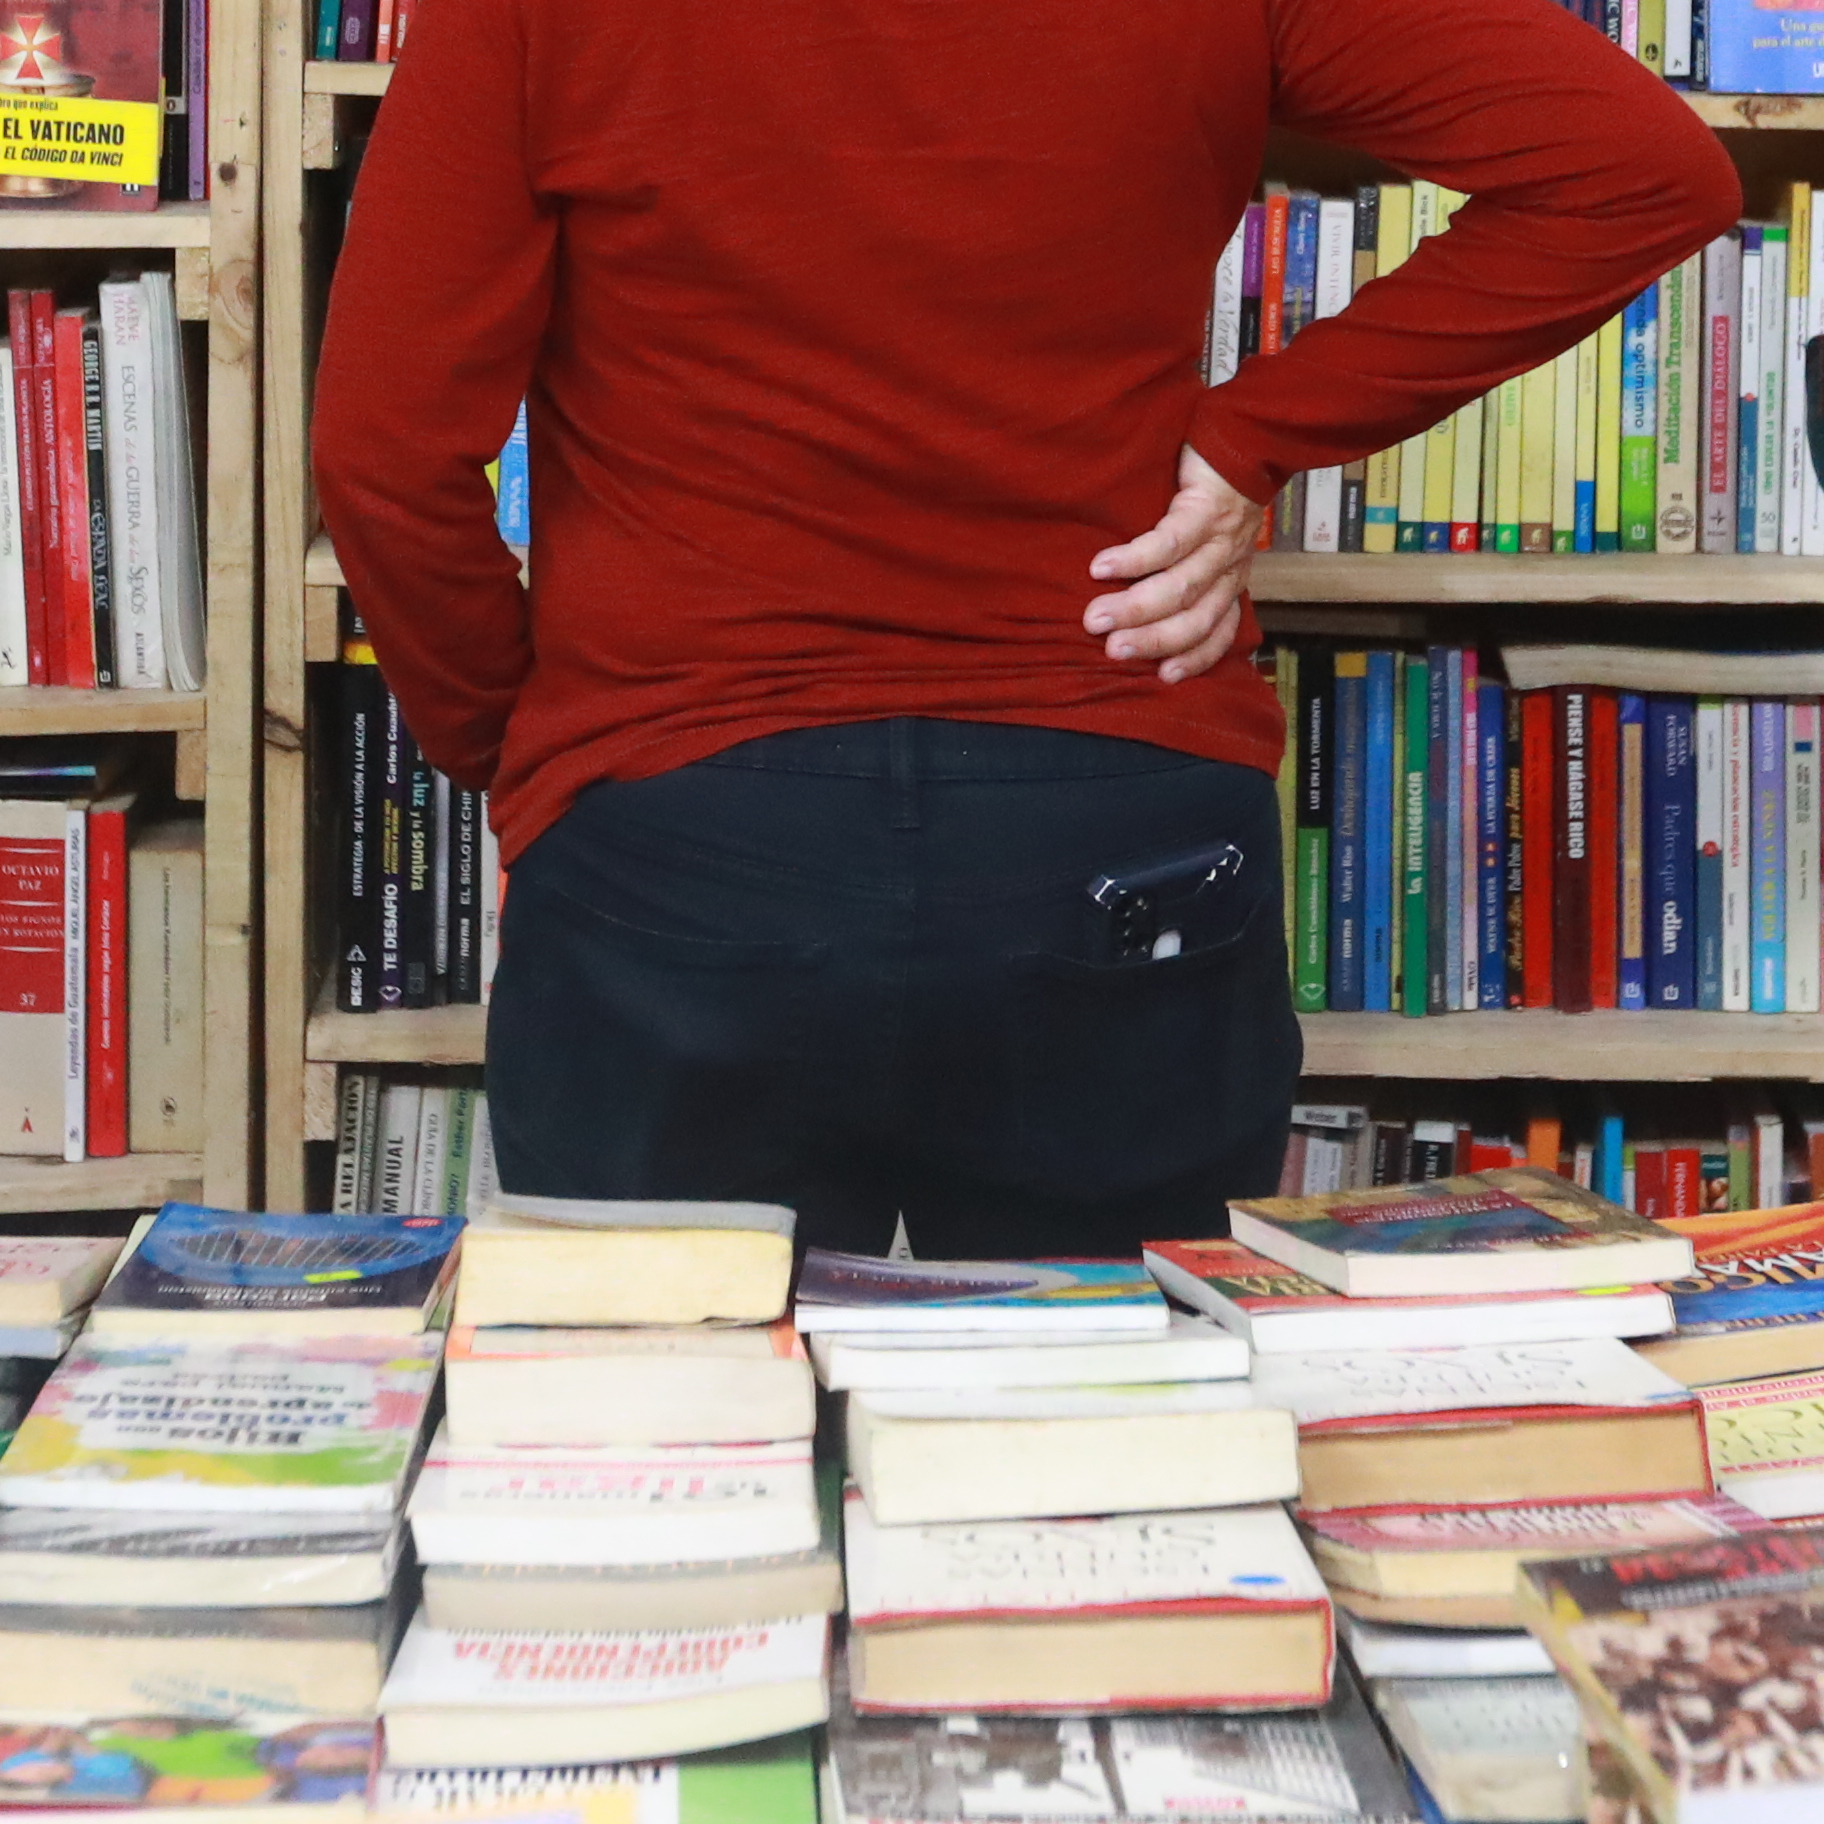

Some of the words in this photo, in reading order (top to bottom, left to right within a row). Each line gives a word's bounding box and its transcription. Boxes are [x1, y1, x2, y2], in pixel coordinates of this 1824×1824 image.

[3, 117, 23, 139] EL
[30, 119, 125, 145] VATICANO
[4, 146, 19, 162] EL
[22, 145, 66, 164] CÓDIGO
[70, 150, 86, 165] DA
[90, 151, 123, 166] VINCI
[121, 365, 138, 432] ESCENAS
[1631, 343, 1648, 429] optimismo
[1663, 374, 1682, 464] Meditación
[125, 466, 142, 529] GUERRA
[1567, 694, 1583, 745] PIENSE
[1568, 748, 1583, 757] Y
[411, 831, 426, 891] sombra
[1568, 823, 1585, 858] RICO
[383, 952, 398, 971] TE
[382, 1136, 404, 1214] MANUAL
